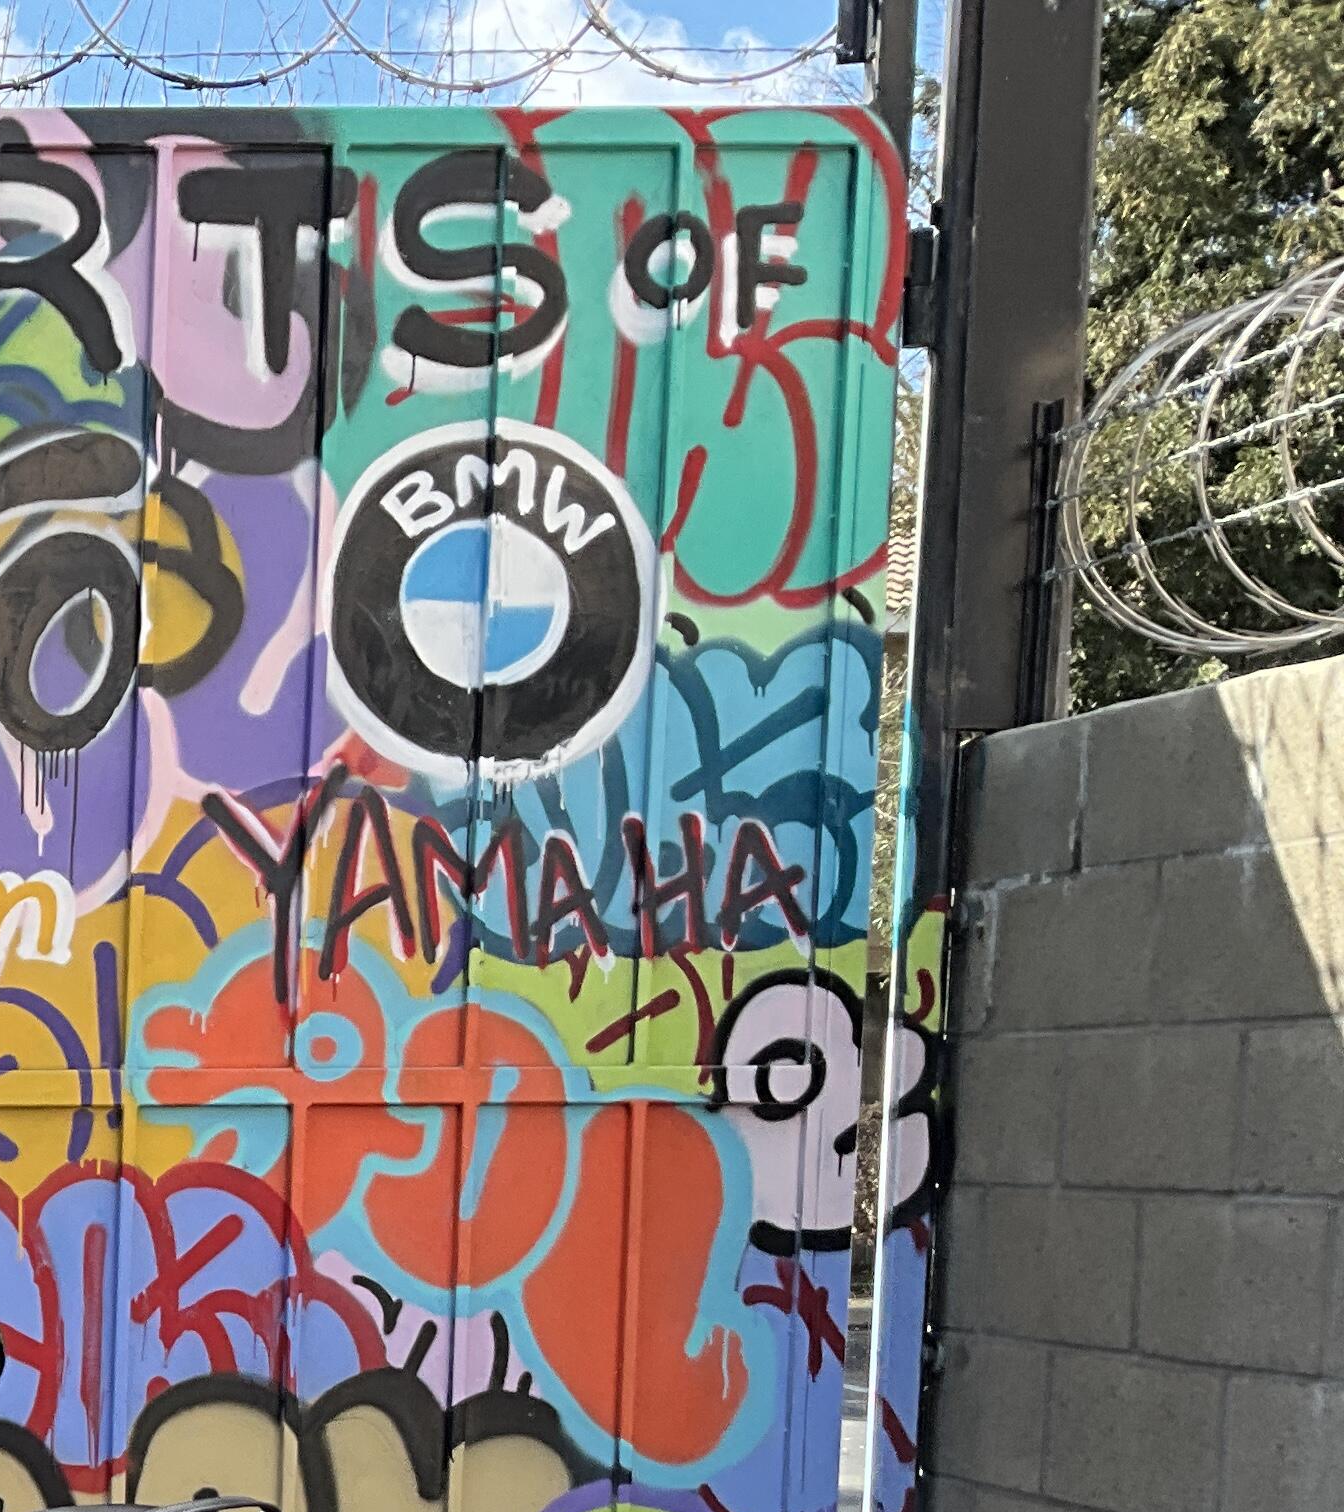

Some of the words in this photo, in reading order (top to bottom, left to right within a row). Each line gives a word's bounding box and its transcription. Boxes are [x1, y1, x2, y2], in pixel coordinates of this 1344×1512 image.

[622, 200, 810, 330] OF
[379, 447, 618, 554] BMW
[201, 762, 812, 1012] YAMAHA
